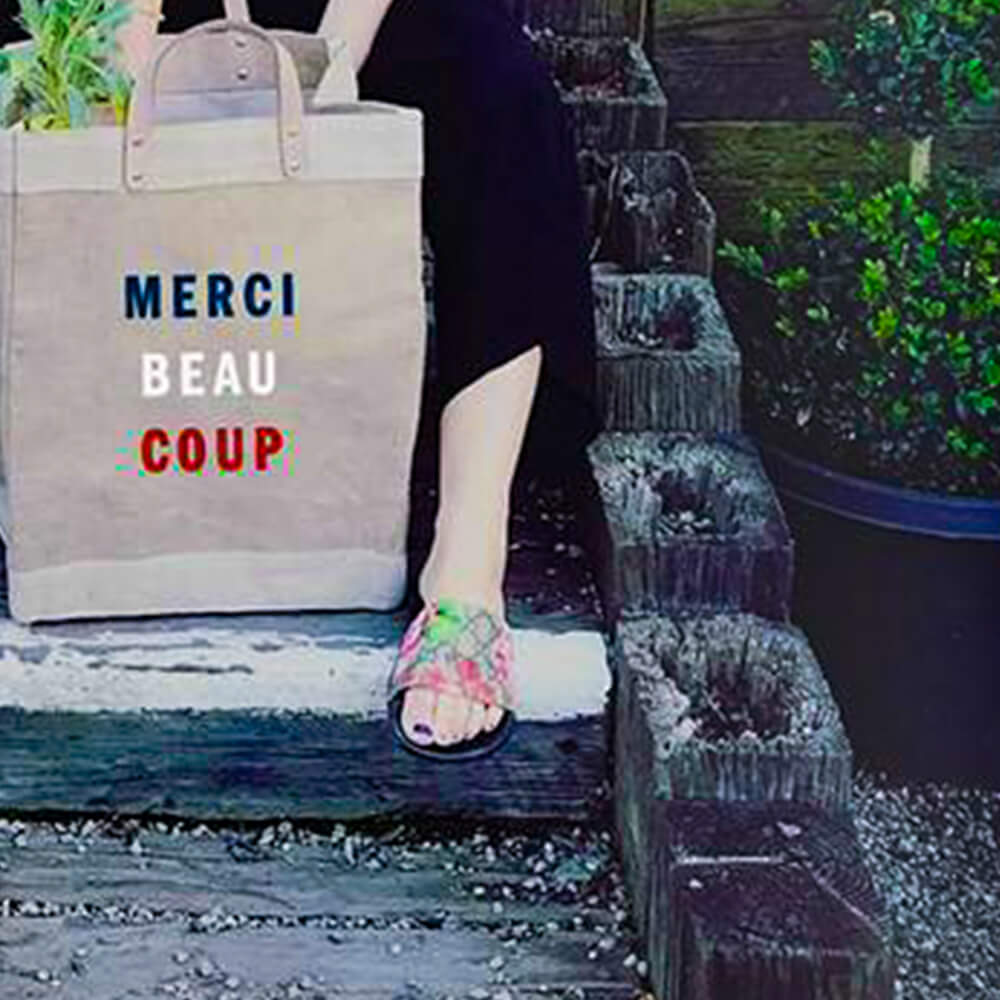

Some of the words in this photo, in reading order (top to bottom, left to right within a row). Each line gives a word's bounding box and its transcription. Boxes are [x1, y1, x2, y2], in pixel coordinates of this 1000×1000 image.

[124, 272, 294, 319] MERCI
[140, 351, 276, 397] BEAU
[140, 427, 284, 474] COUP
